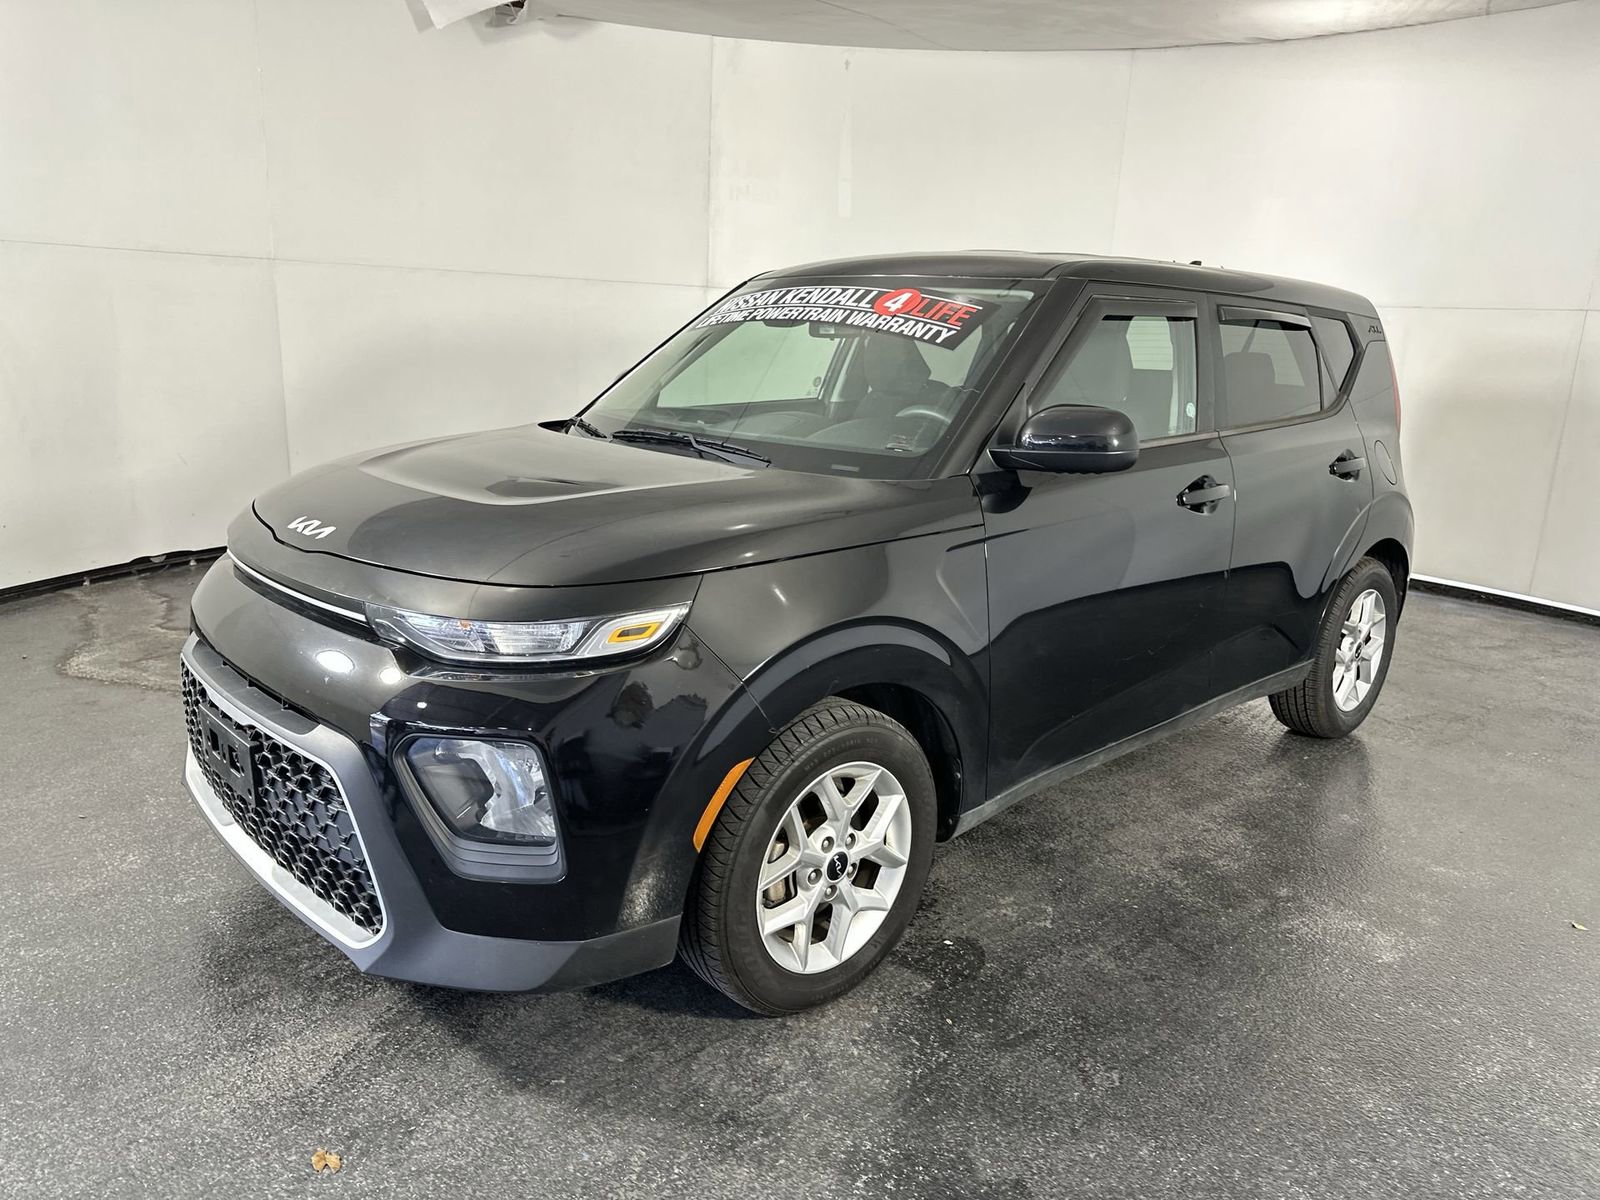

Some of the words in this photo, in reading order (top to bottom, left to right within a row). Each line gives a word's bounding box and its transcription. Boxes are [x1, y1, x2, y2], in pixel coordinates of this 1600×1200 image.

[712, 290, 786, 315] NISSAN
[778, 288, 879, 308] KENDALL
[883, 292, 912, 312] 4
[911, 299, 977, 326] LIFE
[746, 307, 851, 323] POWERTRAIN
[845, 310, 957, 344] WARRANTY
